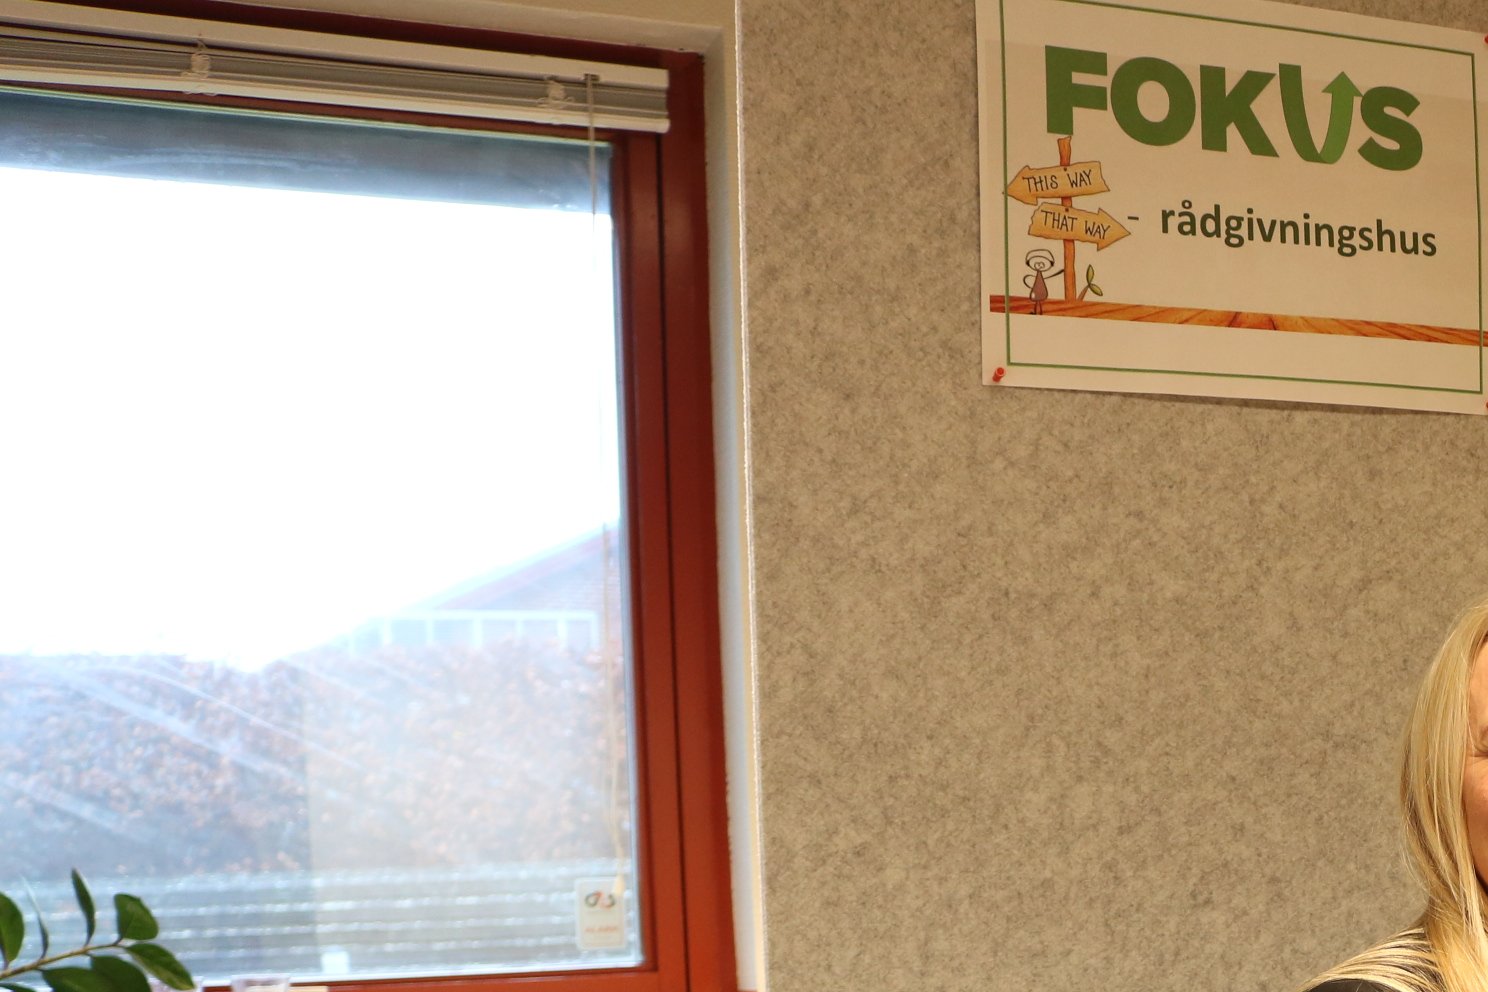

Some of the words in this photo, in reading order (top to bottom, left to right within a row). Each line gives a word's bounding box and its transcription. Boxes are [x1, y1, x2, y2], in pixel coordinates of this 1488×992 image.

[1045, 45, 1423, 171] FOKUS
[1022, 175, 1058, 193] THIS
[1067, 169, 1092, 188] WAY
[1041, 210, 1078, 232] THAT
[1084, 220, 1111, 240] WAY
[1161, 200, 1437, 257] rådgivningshus
